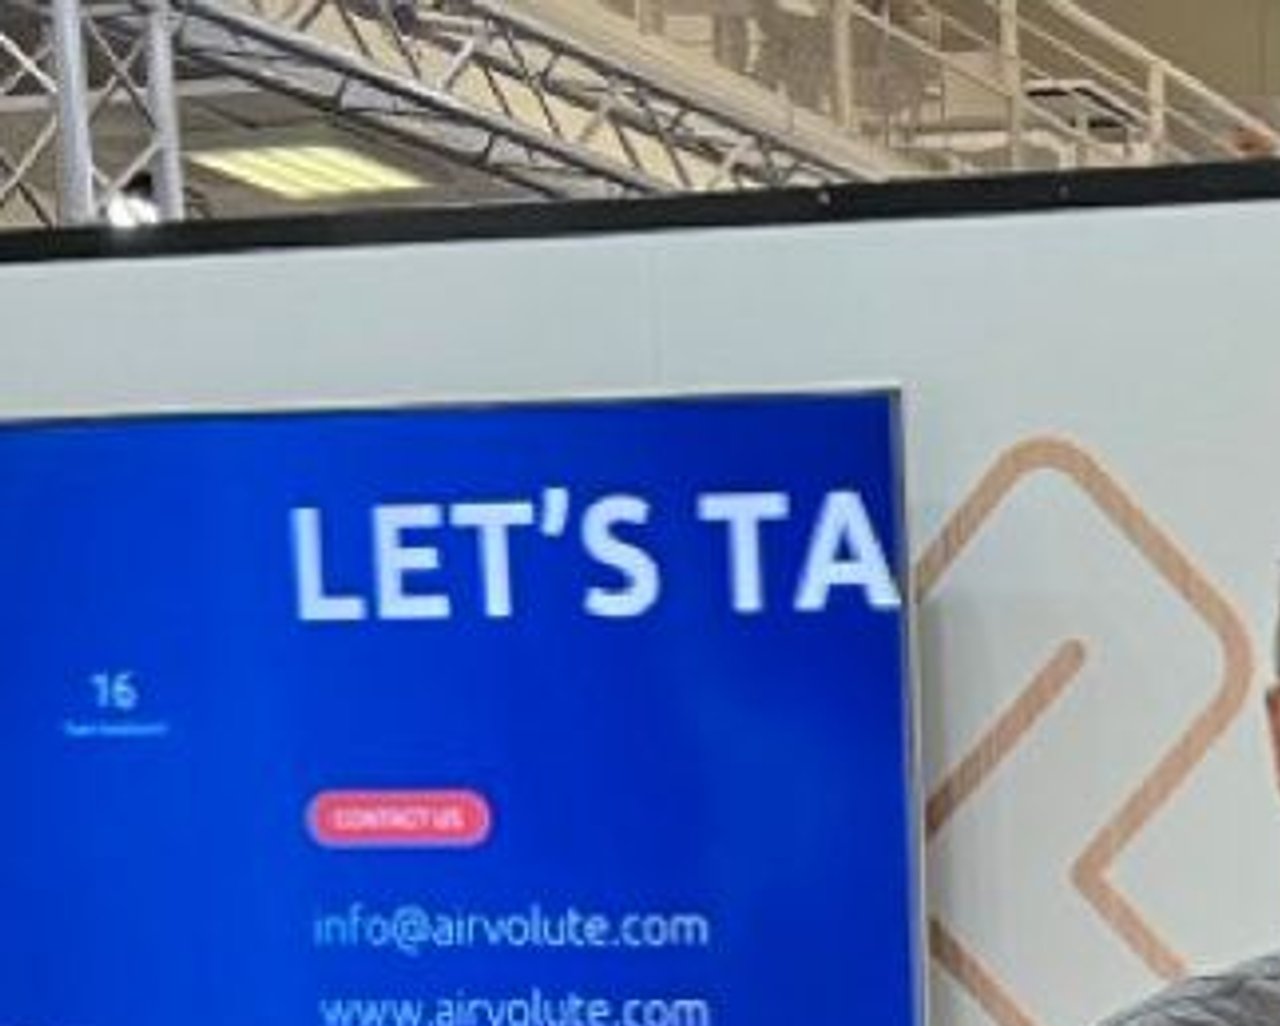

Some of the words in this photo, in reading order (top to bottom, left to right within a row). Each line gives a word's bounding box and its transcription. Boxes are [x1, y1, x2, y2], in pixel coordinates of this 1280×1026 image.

[290, 488, 662, 620] LET'S
[696, 490, 902, 612] TA
[90, 669, 139, 709] 16
[333, 806, 430, 831] CONTACT
[313, 902, 710, 956] info@airvolute.com
